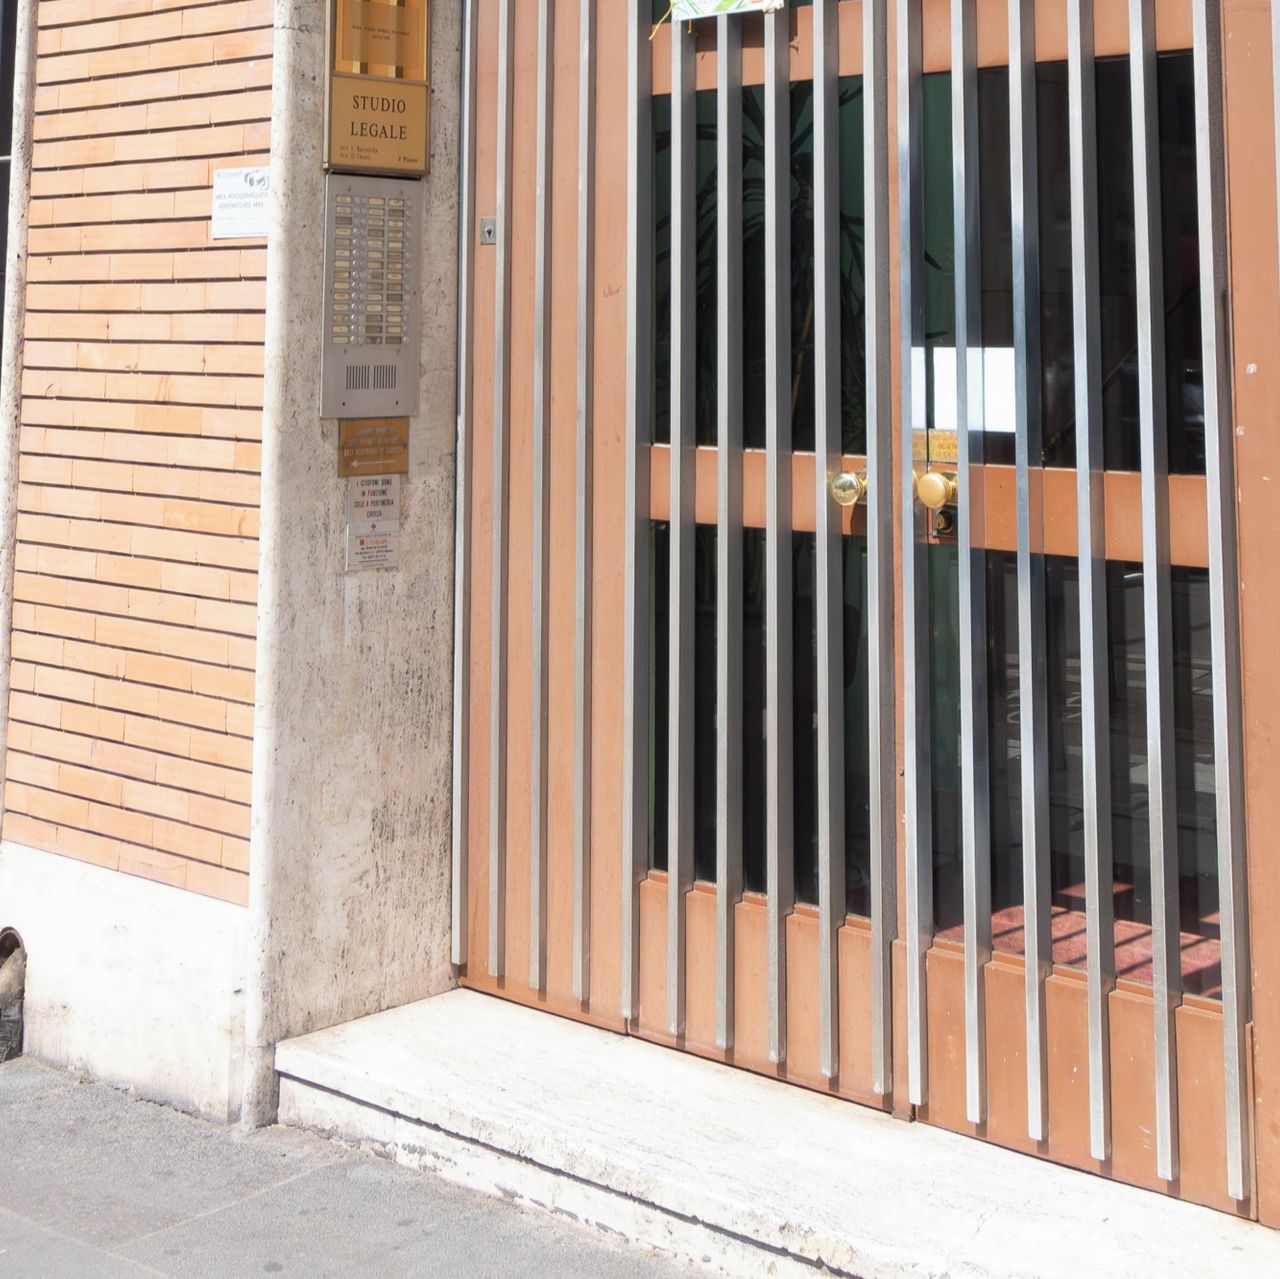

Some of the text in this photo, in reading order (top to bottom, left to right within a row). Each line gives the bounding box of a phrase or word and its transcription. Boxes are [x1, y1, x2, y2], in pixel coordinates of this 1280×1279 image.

[352, 94, 407, 114] STUDIO
[350, 121, 408, 140] LEGALE
[367, 488, 388, 497] FUNZIONE
[353, 500, 364, 509] SOLO
[370, 498, 394, 507] PORTINERIA
